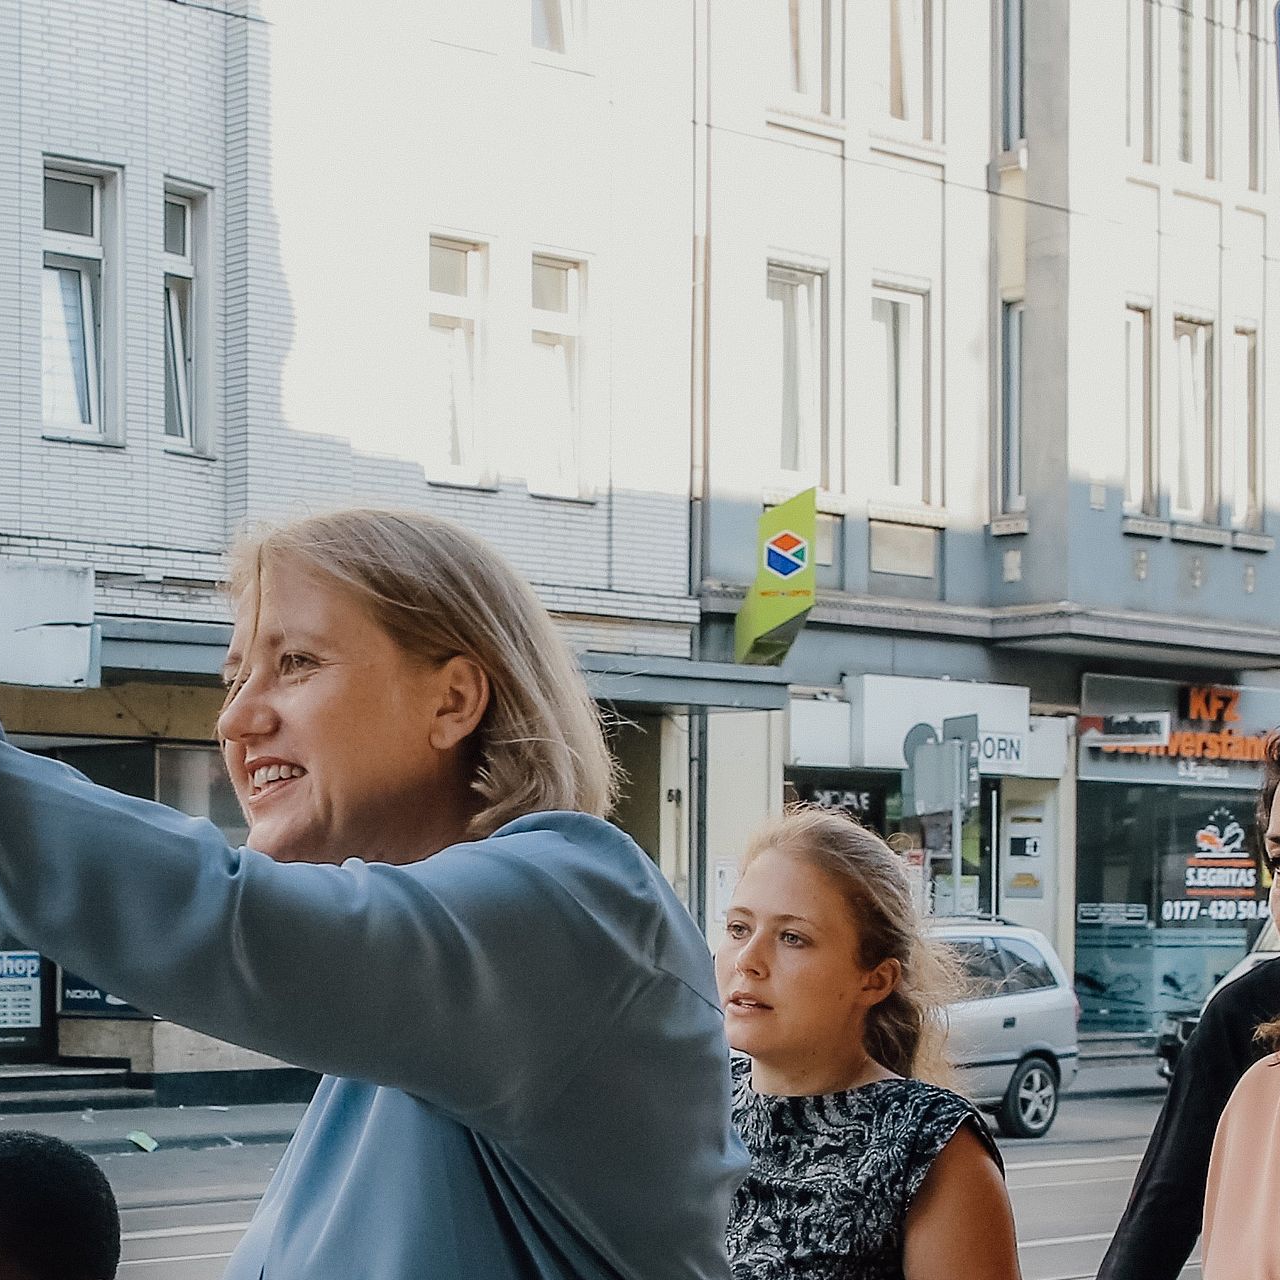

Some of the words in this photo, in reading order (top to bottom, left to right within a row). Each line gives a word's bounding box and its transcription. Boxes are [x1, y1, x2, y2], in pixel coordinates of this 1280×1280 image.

[1189, 686, 1241, 722] KFZ
[977, 737, 1021, 760] ORN
[65, 988, 102, 1000] NOKIA
